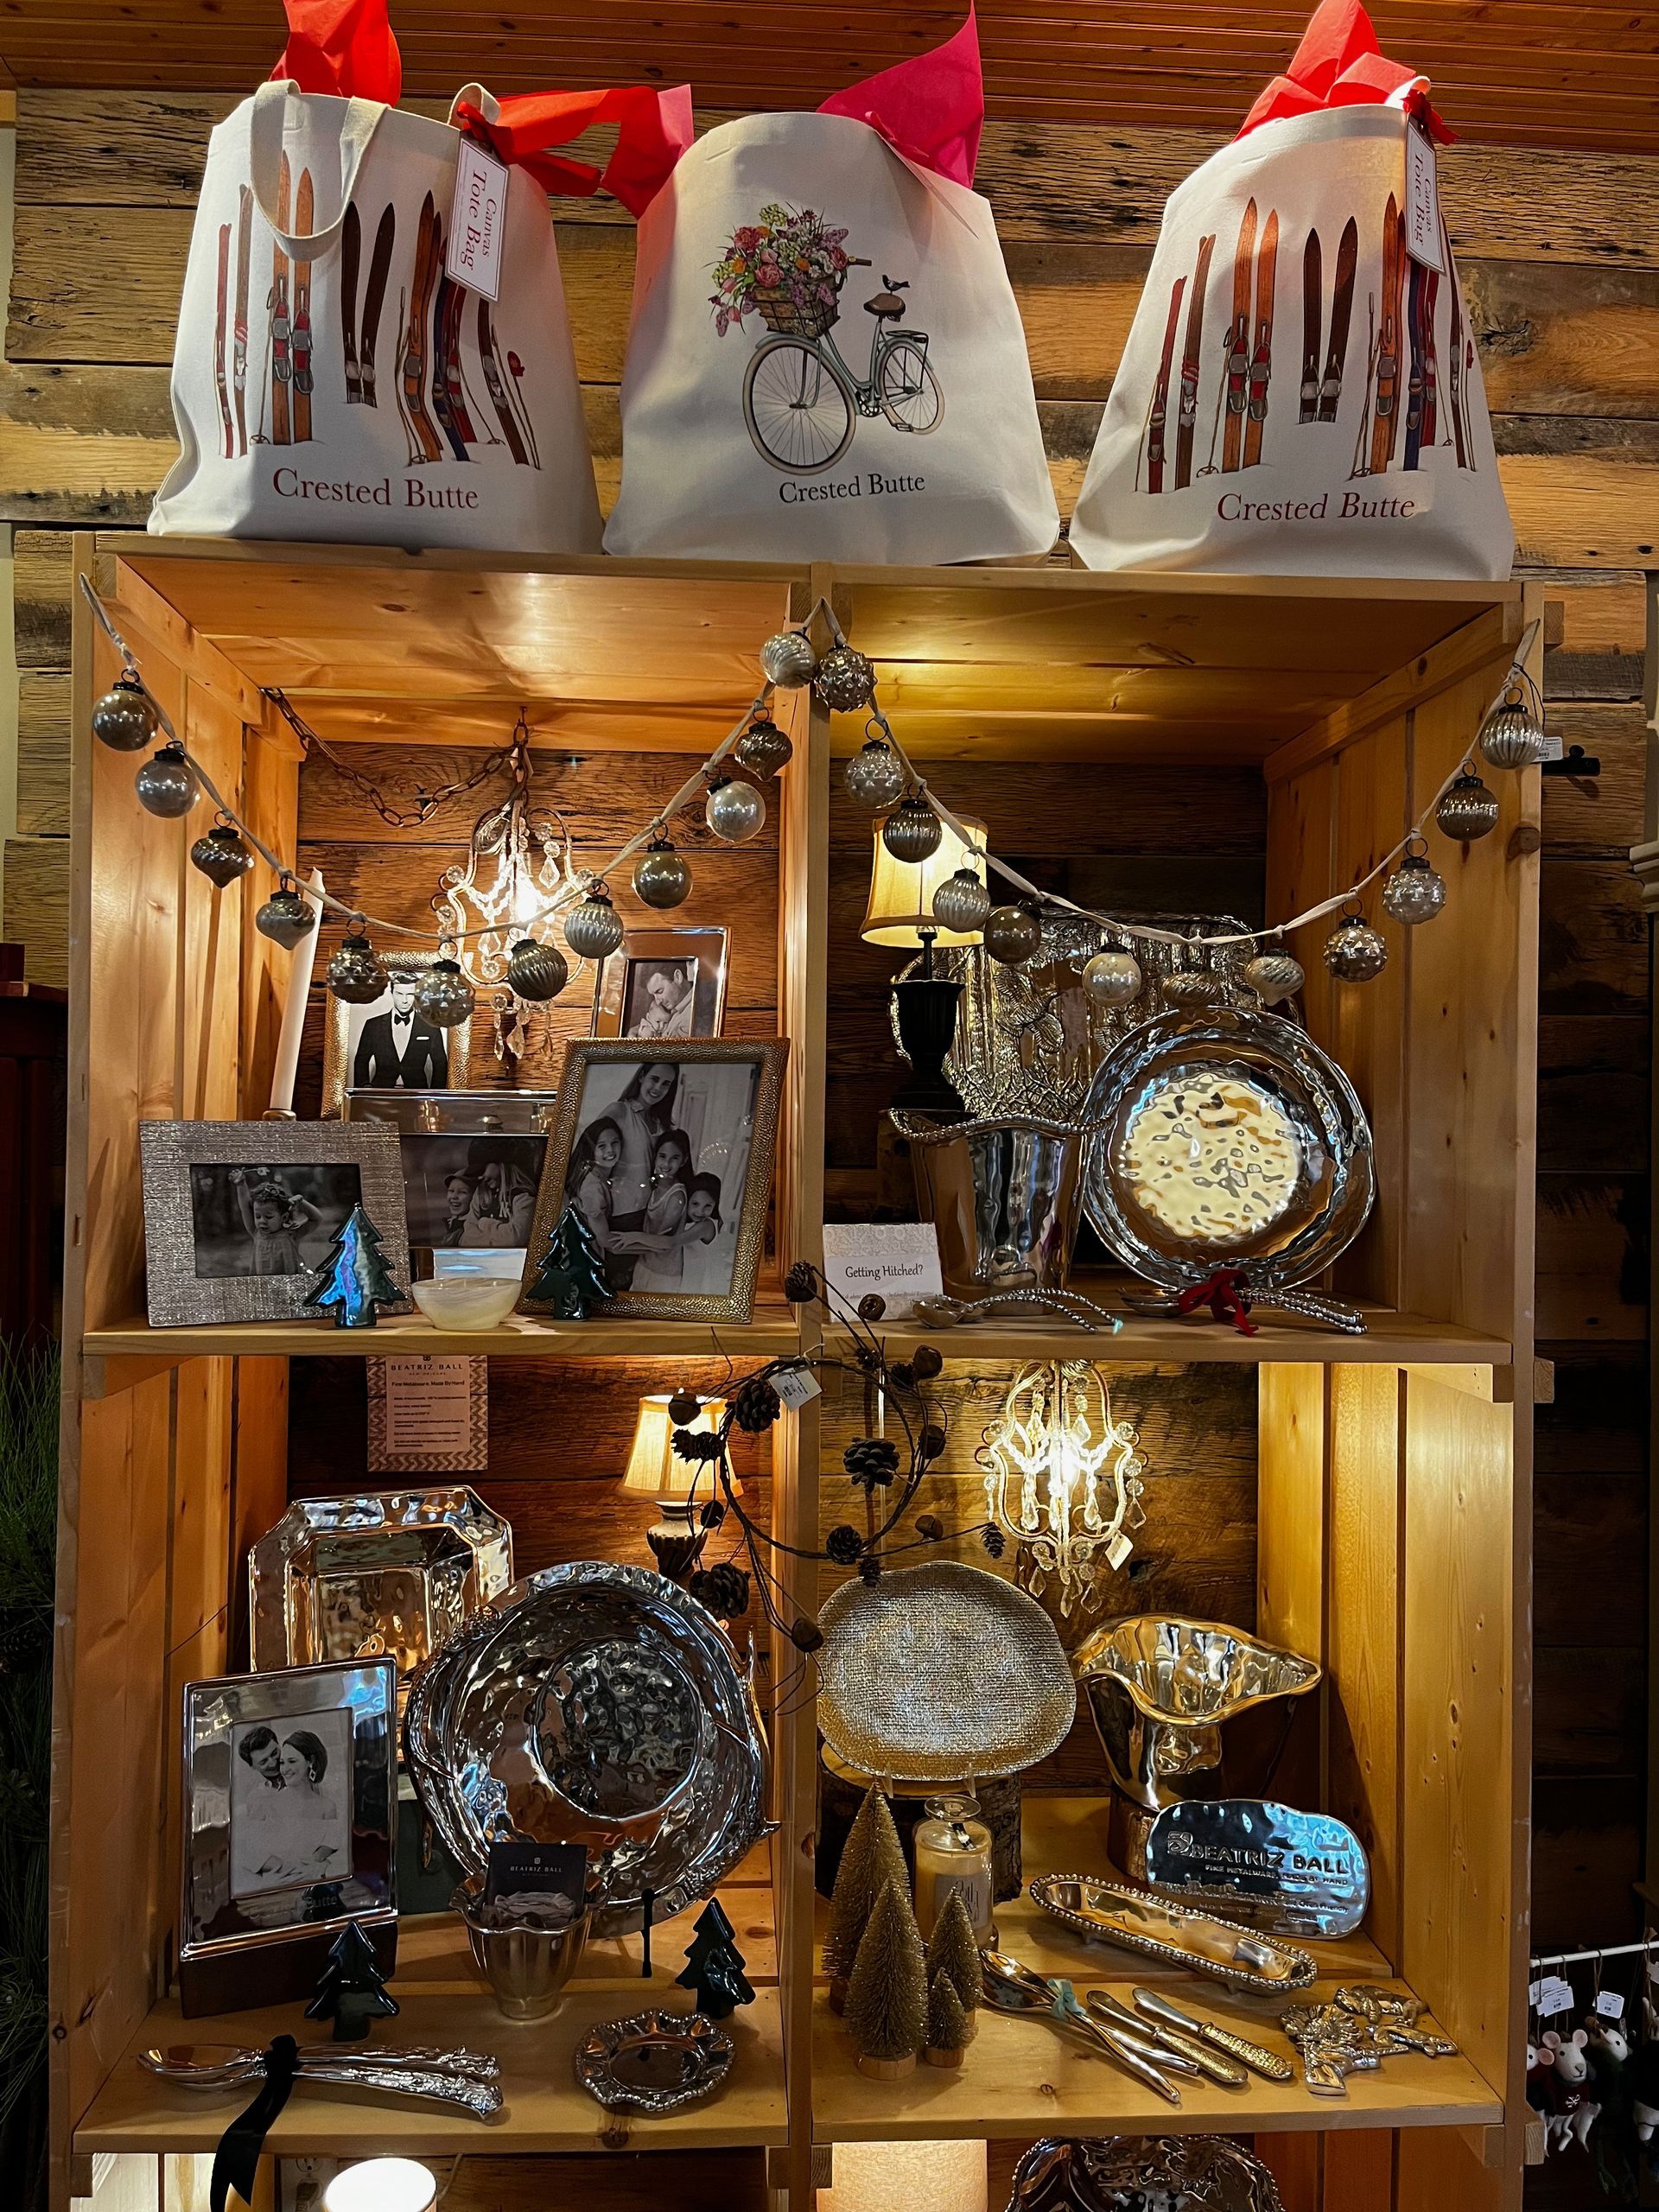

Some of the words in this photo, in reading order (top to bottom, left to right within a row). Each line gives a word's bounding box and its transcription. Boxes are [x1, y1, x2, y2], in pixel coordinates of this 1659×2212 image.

[468, 171, 487, 219] Tote
[1414, 155, 1424, 196] Tote
[1413, 204, 1425, 246] Bag
[1424, 178, 1433, 233] Canvas
[460, 224, 482, 271] Bag
[482, 198, 498, 257] Canvas
[272, 467, 392, 506] Crested
[404, 478, 480, 510] Butte
[779, 475, 862, 504] Crested
[867, 473, 926, 495] Butte
[1217, 493, 1329, 521] Crested
[1337, 492, 1415, 518] Butte
[844, 1266, 881, 1281] Getting
[881, 1262, 924, 1276] Hitched?
[1190, 1843, 1284, 1869] BEATRIZ
[1293, 1853, 1350, 1874] BALL
[1205, 1864, 1225, 1873] FINE
[1322, 1877, 1348, 1885] HAND
